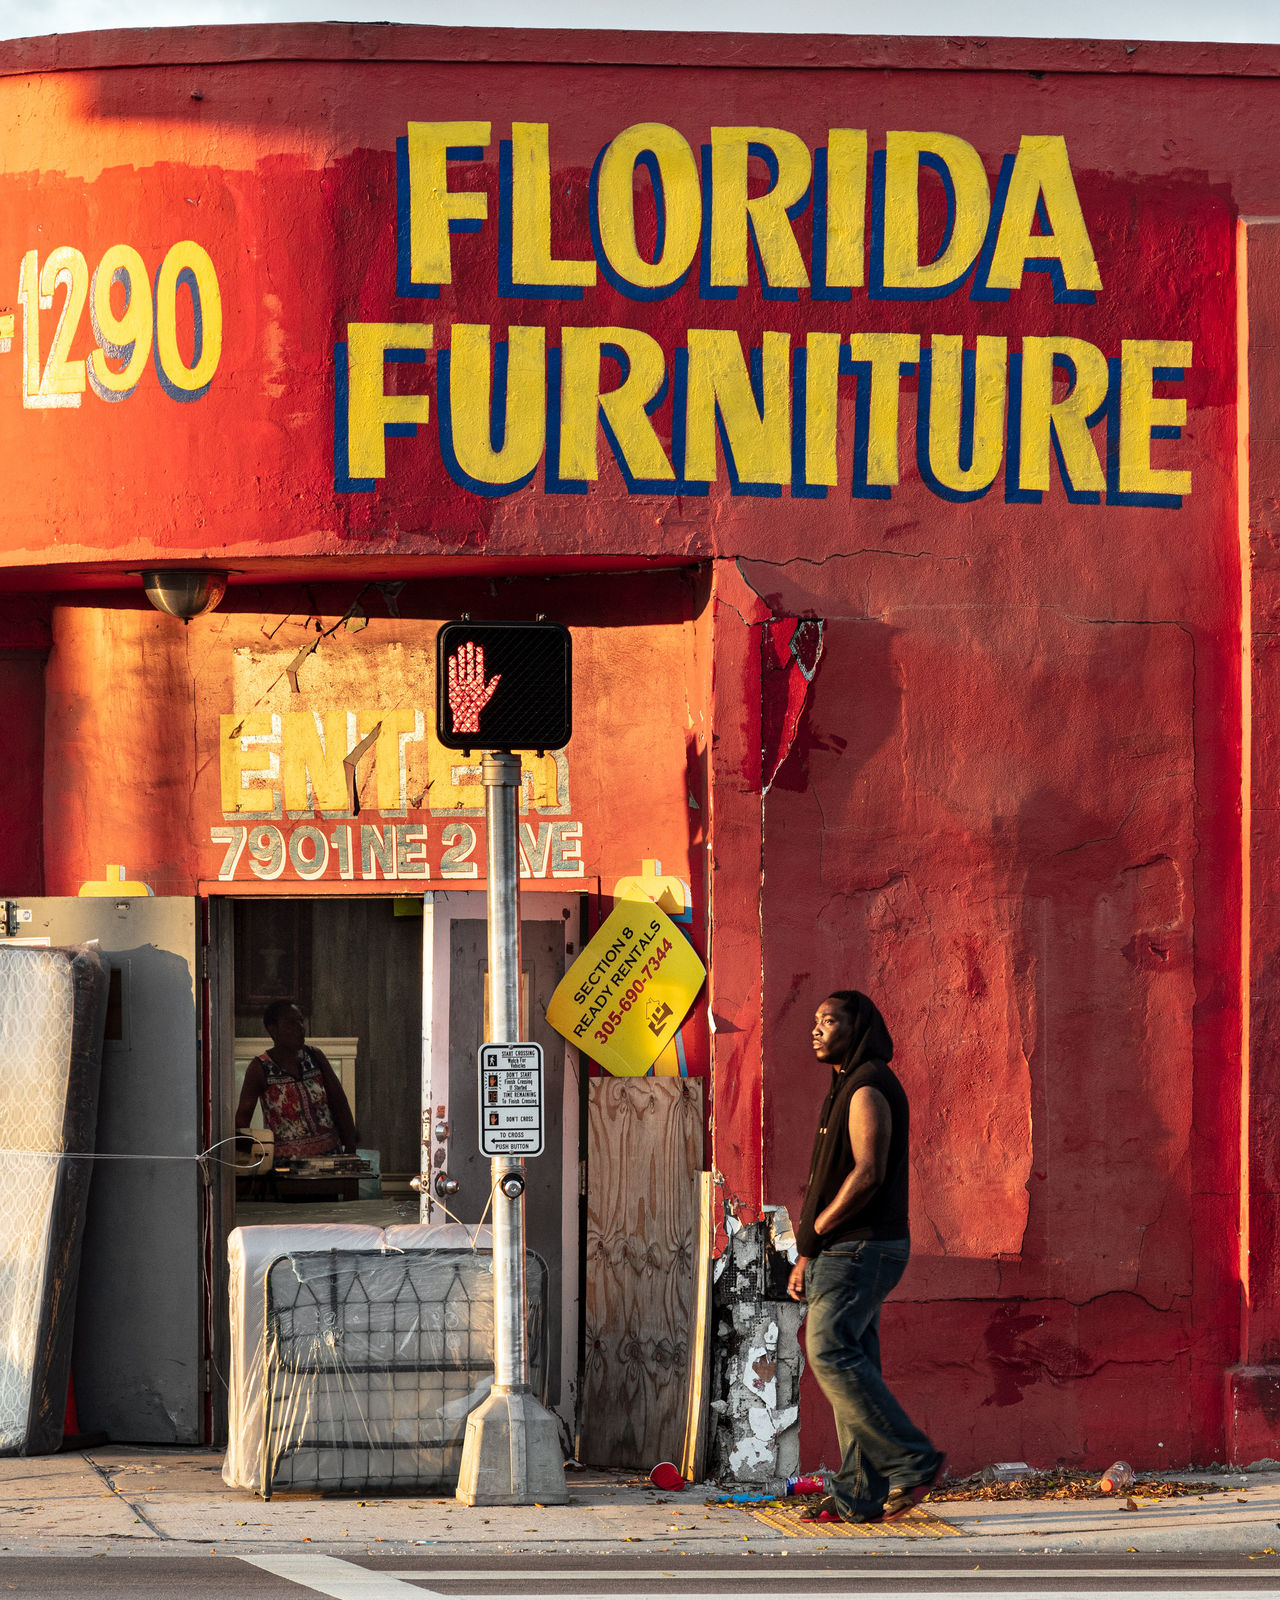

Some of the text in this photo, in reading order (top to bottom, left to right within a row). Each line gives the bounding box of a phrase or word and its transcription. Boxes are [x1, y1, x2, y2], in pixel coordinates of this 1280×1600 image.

[397, 120, 1103, 304] FLORIDA
[334, 321, 1194, 508] FURNITURE
[210, 821, 585, 881] 7901 NE 2 VE
[573, 926, 635, 1005] SECTION 8
[573, 919, 662, 1038] READY RENTALS
[594, 937, 673, 1045] 305-690-7344
